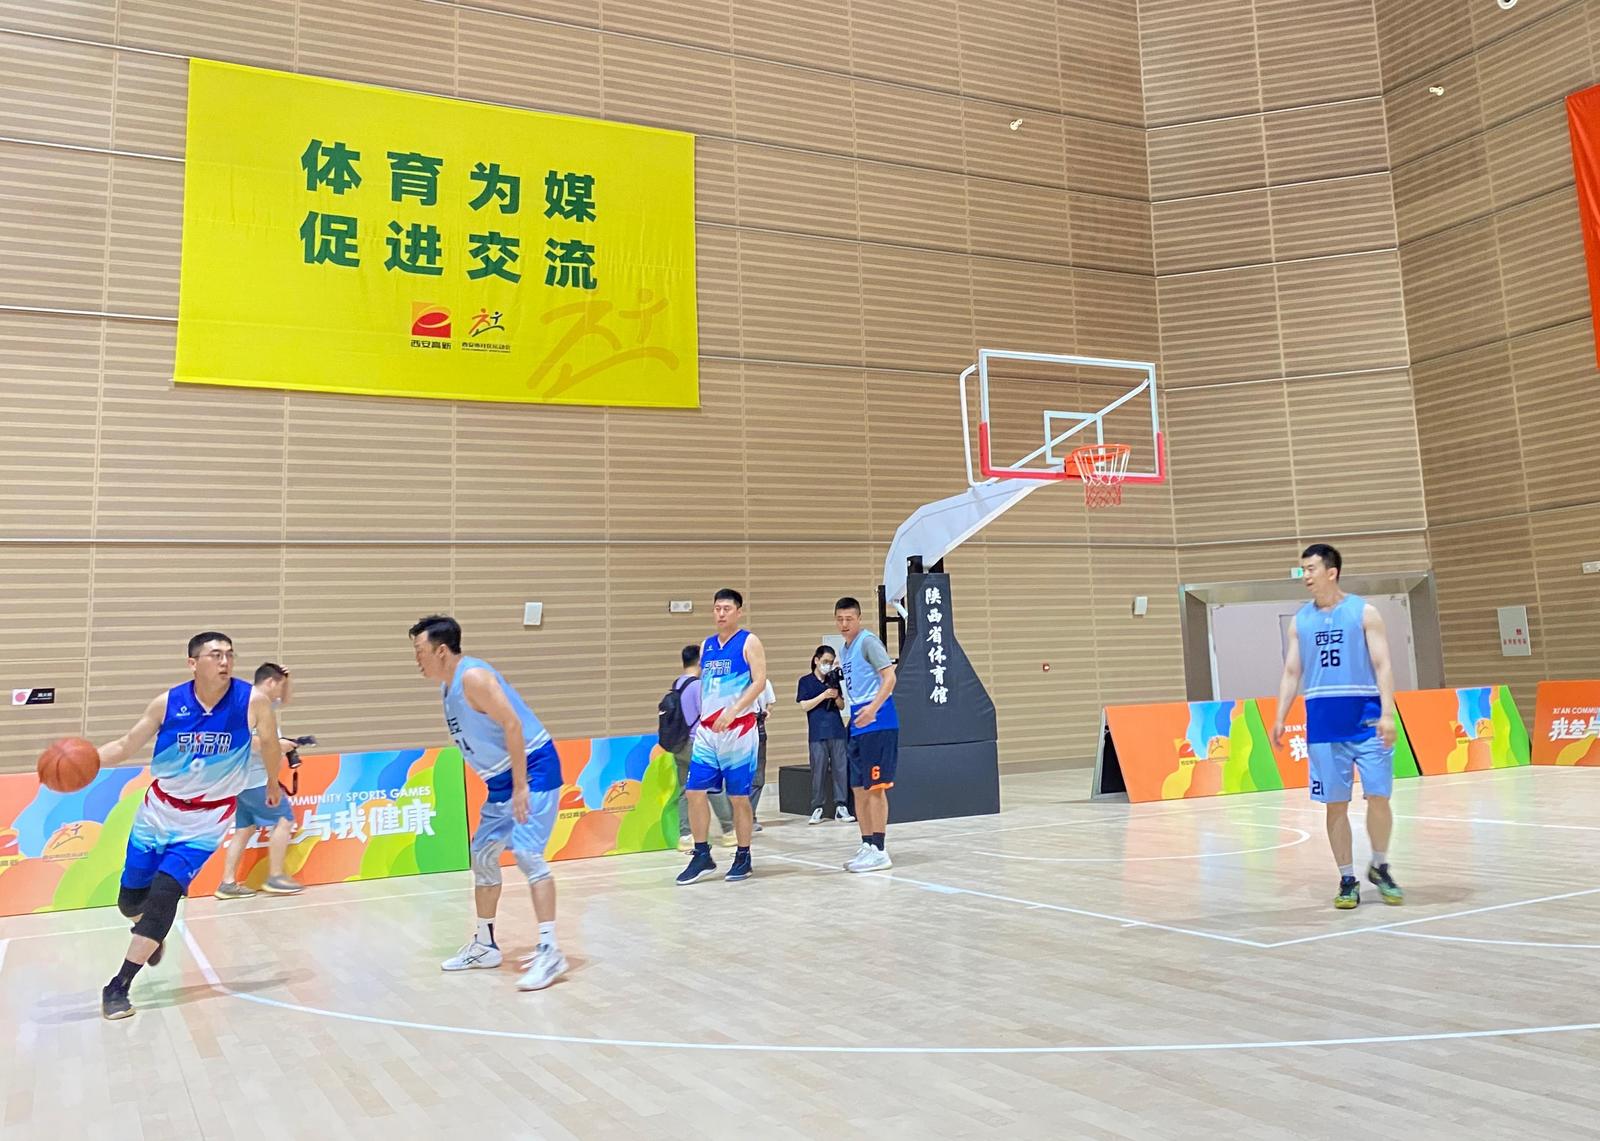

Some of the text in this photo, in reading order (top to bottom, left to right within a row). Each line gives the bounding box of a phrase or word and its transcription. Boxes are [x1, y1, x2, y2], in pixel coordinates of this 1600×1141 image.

[300, 139, 597, 223] 体育为媒
[299, 211, 598, 290] 促进交流
[410, 339, 452, 350] 西安高新
[925, 586, 949, 705] 陕西省体育馆
[1314, 629, 1344, 646] 西安
[1320, 648, 1341, 668] 26
[871, 766, 880, 780] 6
[289, 785, 432, 806] MMUNITY SPORTS GAMES
